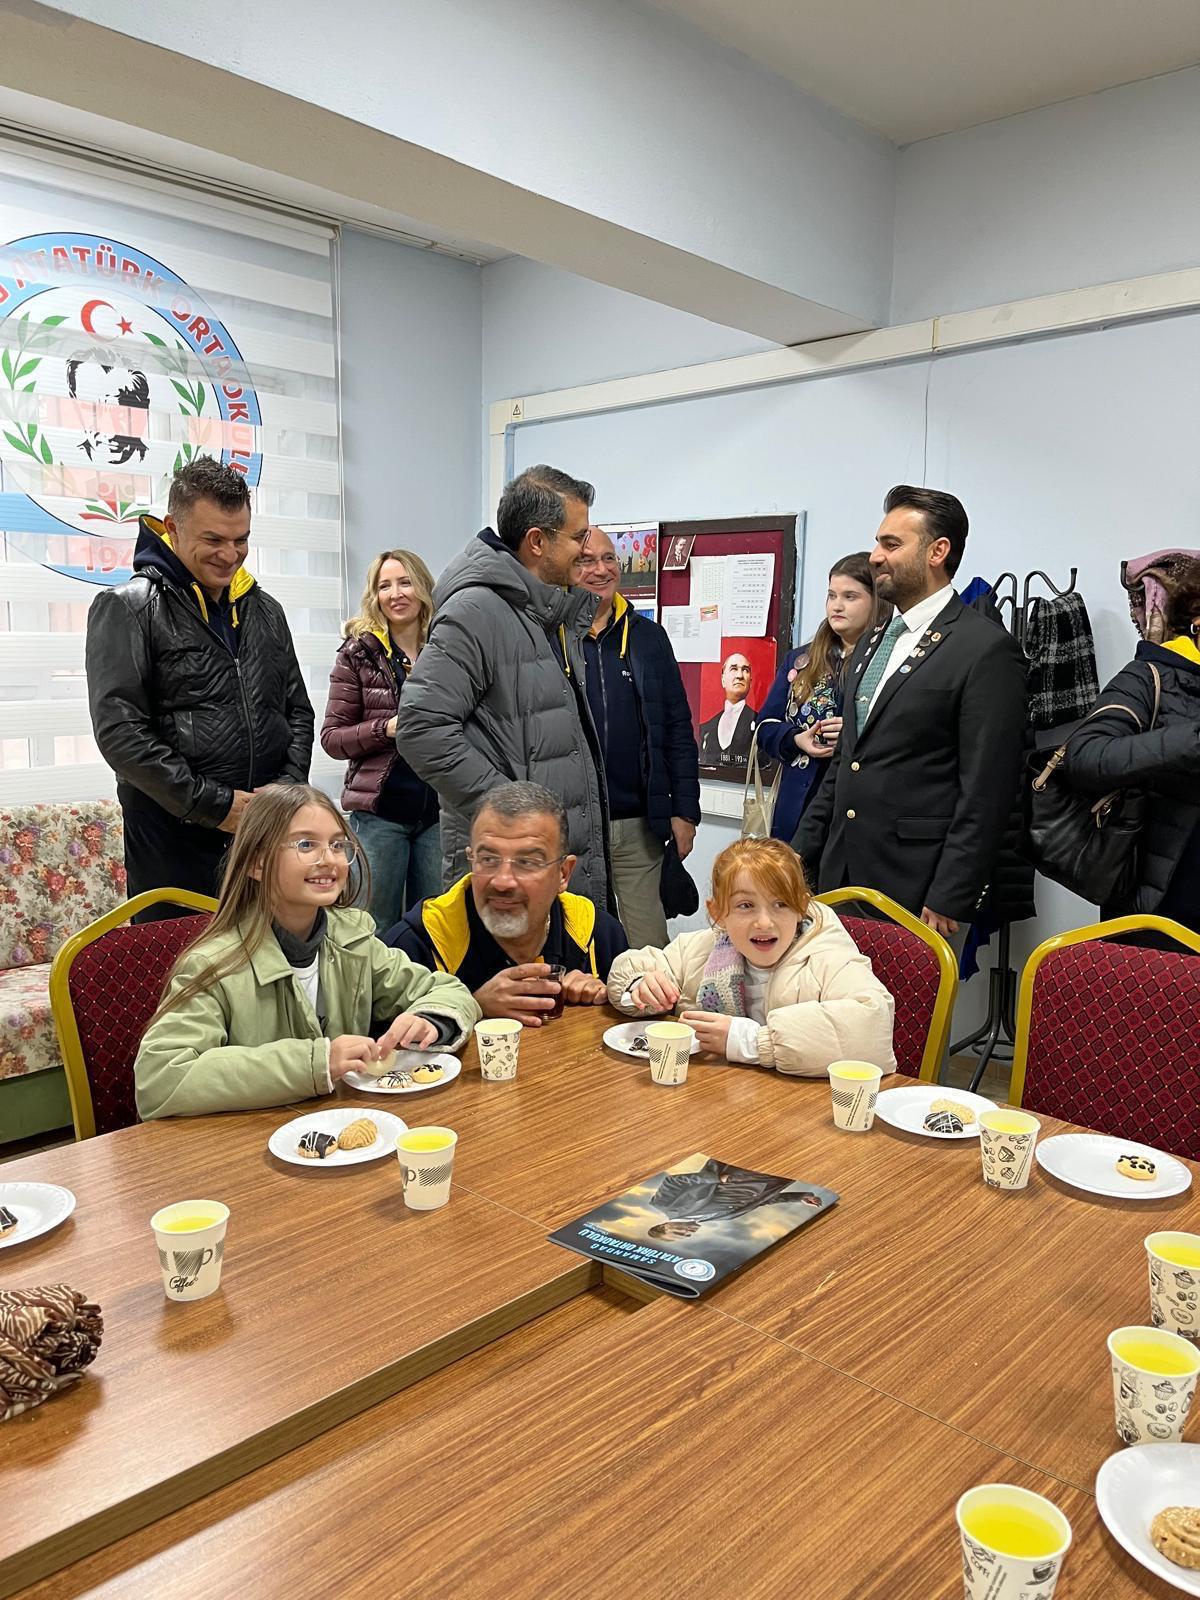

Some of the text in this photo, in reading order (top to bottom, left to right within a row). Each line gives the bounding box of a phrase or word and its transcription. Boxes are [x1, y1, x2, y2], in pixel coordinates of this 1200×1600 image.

[11, 244, 169, 302] ATATÜRK
[577, 1228, 637, 1249] ORTAOKULU
[634, 1245, 684, 1264] ATATÜRK
[169, 1275, 195, 1293] Coffee
